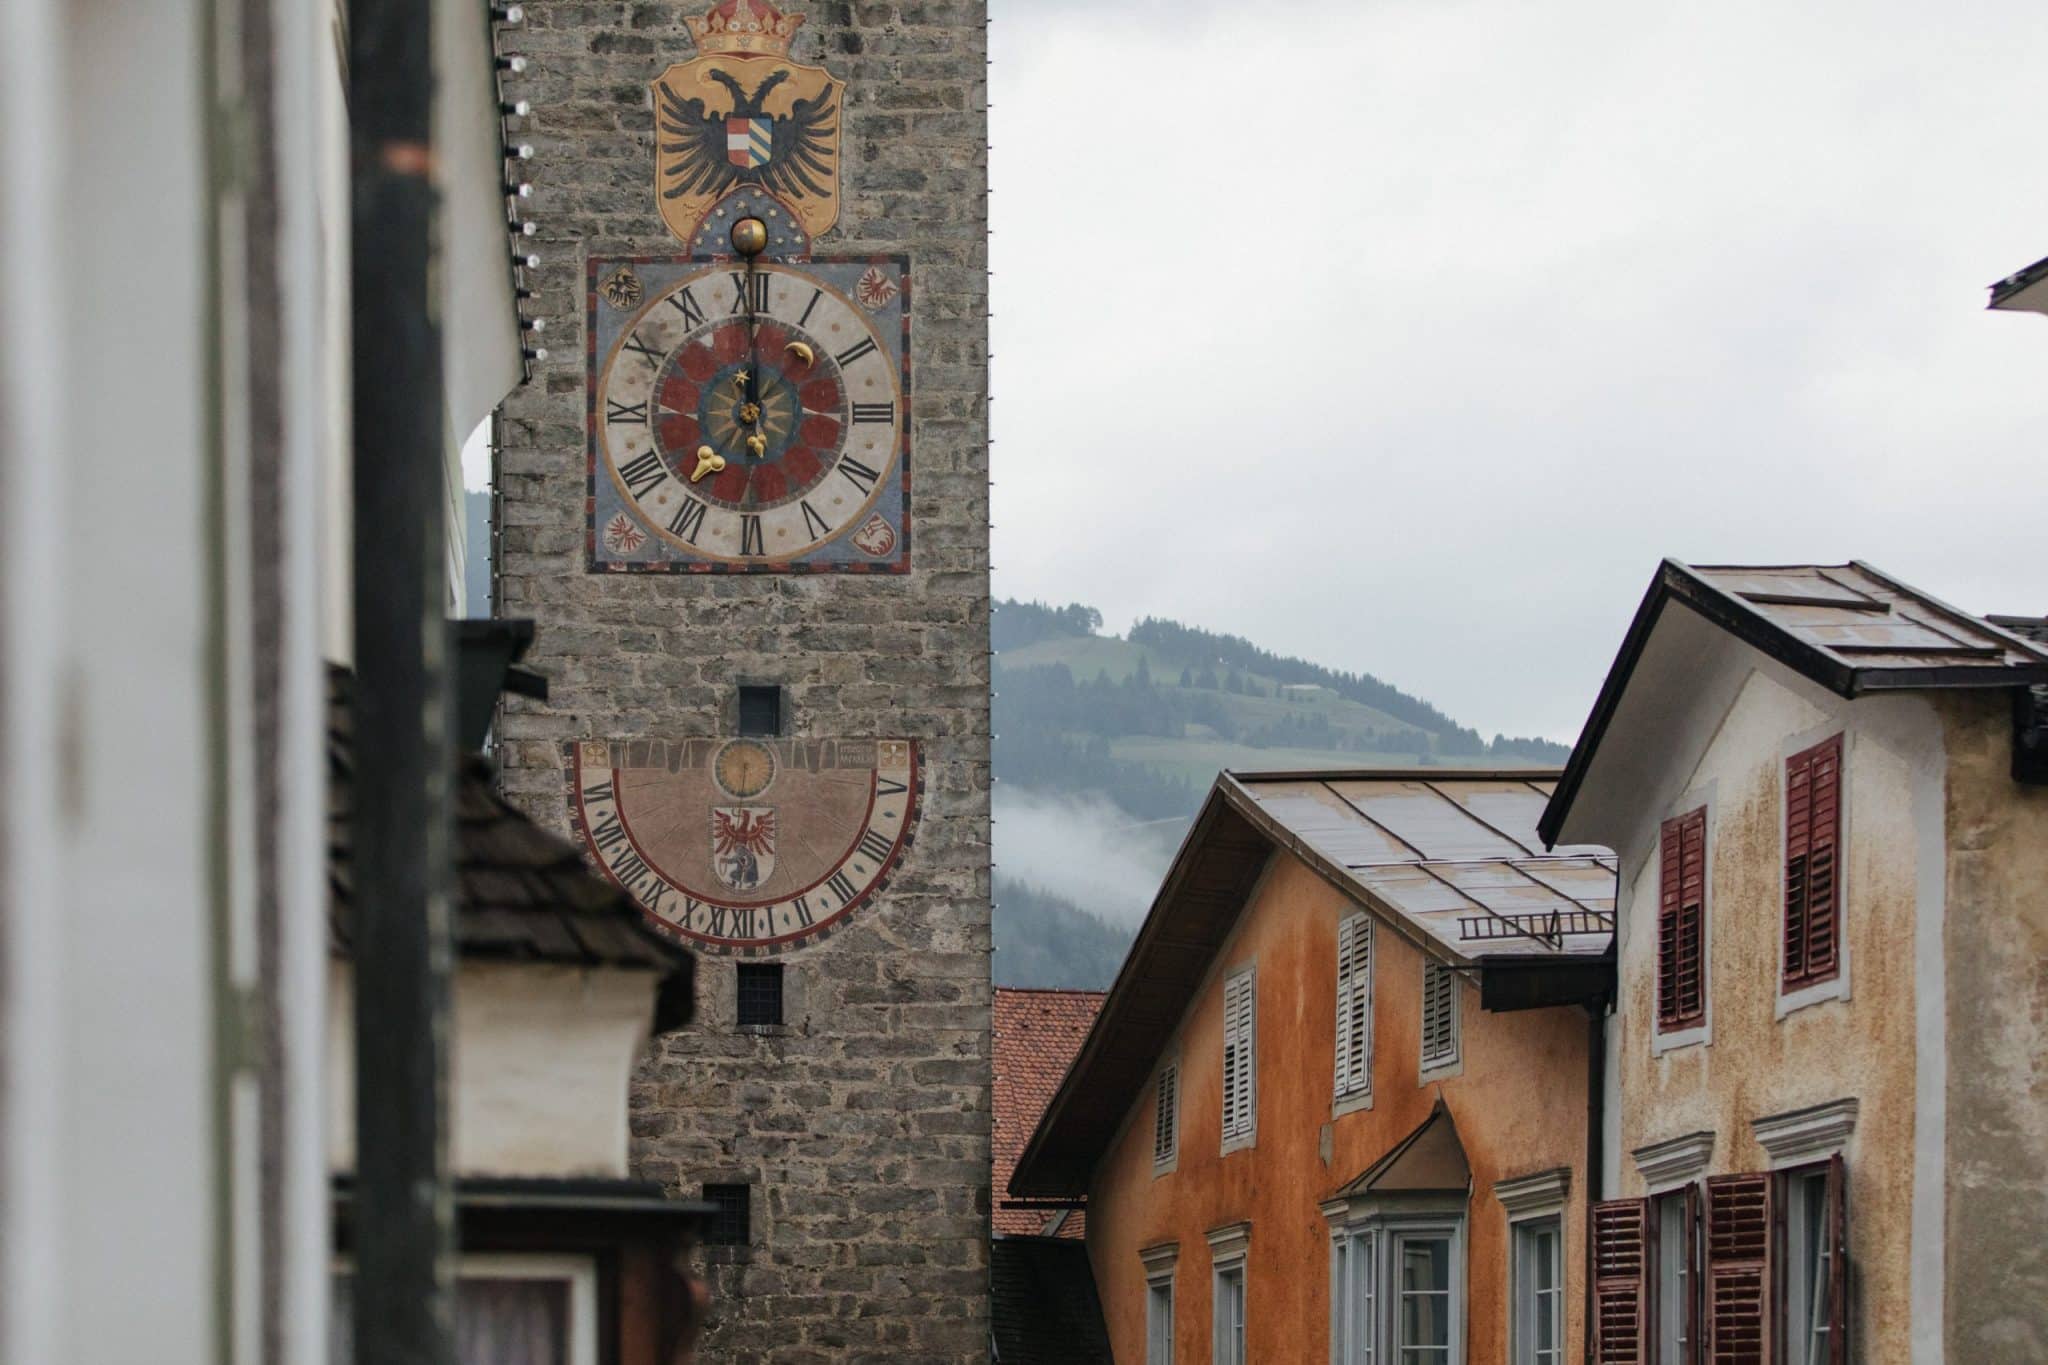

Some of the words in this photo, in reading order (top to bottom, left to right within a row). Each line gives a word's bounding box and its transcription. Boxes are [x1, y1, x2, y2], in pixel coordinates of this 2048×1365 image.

[664, 285, 708, 333] XI
[797, 288, 823, 328] I
[622, 328, 671, 371] X
[835, 336, 878, 370] II
[607, 398, 648, 428] IX
[852, 400, 894, 426] III
[617, 448, 668, 502] VIII
[837, 453, 881, 496] IV
[665, 494, 707, 546] VII
[739, 514, 766, 556] VI
[800, 499, 832, 541] V
[583, 779, 614, 805] VI
[877, 776, 908, 797] V
[592, 811, 627, 852] VII
[856, 827, 895, 866] IIII
[611, 843, 652, 889] VIII
[640, 876, 675, 913] IX
[824, 869, 858, 906] III
[676, 895, 702, 930] X
[766, 906, 777, 937] I
[792, 896, 817, 928] II
